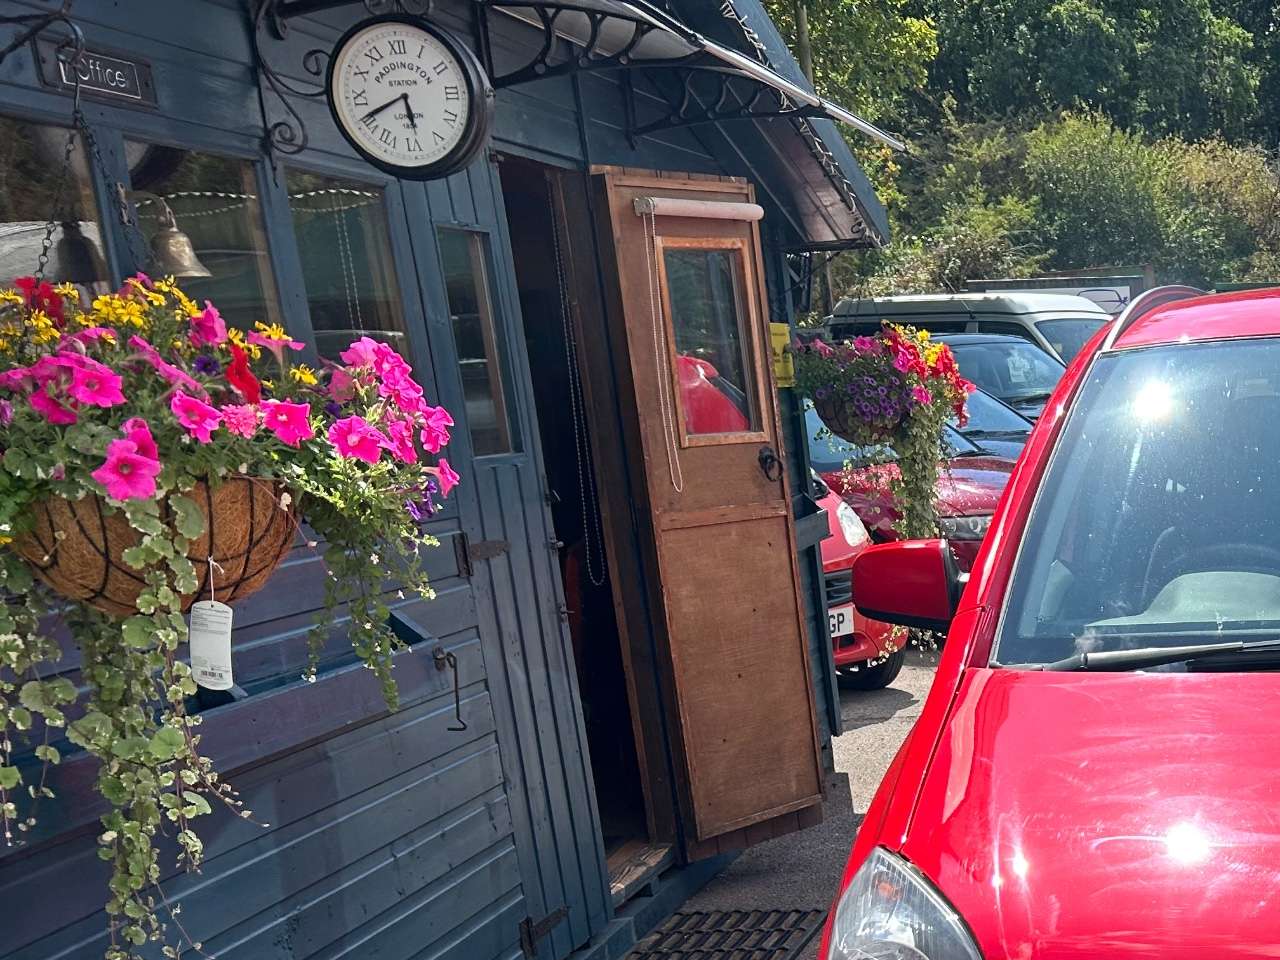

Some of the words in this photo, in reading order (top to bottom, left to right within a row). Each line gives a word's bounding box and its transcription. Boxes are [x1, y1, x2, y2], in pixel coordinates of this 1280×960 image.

[388, 40, 407, 55] XII
[417, 45, 425, 58] I
[364, 46, 383, 66] XI
[353, 65, 369, 82] X
[374, 61, 433, 85] PADDINGTON
[433, 60, 448, 75] II
[388, 79, 418, 87] STATION
[352, 89, 368, 107] IX
[444, 86, 459, 100] III
[393, 113, 424, 121] LONON
[379, 128, 397, 149] VII
[406, 137, 424, 152] VI
